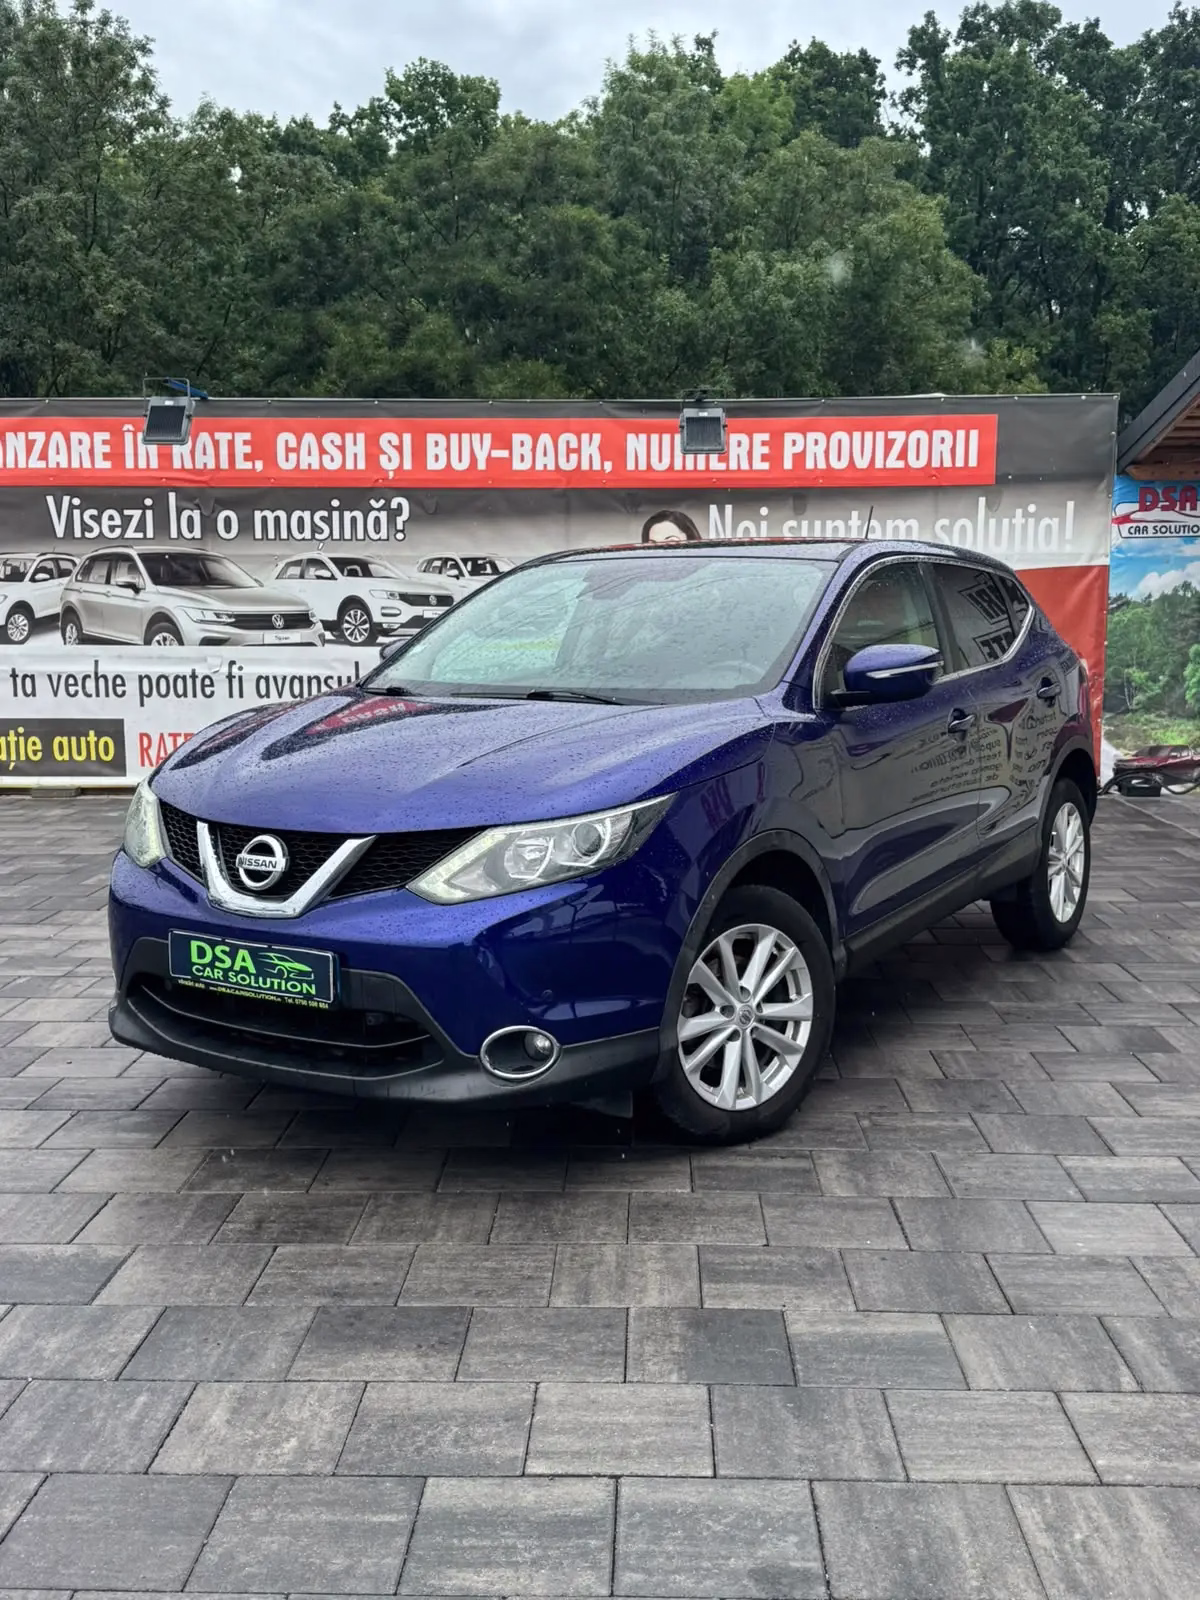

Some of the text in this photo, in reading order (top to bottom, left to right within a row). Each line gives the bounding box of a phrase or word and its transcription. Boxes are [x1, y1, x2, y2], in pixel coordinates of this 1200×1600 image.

[0, 431, 112, 469] NZARE
[172, 431, 264, 472] RATE,
[276, 431, 366, 470] CASH
[379, 431, 412, 480] ȘI
[426, 431, 613, 473] BUY-BACK,
[783, 428, 980, 470] PROVIZORII
[1138, 485, 1198, 512] DSA
[45, 490, 411, 551] Visezi la o mașină?
[1127, 525, 1149, 536] CAR
[10, 667, 37, 698] ta
[46, 659, 127, 699] veche
[138, 668, 216, 707] poate
[225, 660, 245, 699] fi
[53, 730, 115, 762] auto
[138, 731, 195, 768] RAT
[237, 855, 278, 869] NISSAN
[190, 939, 257, 975] DSA
[192, 965, 317, 996] CAR SOLUTION
